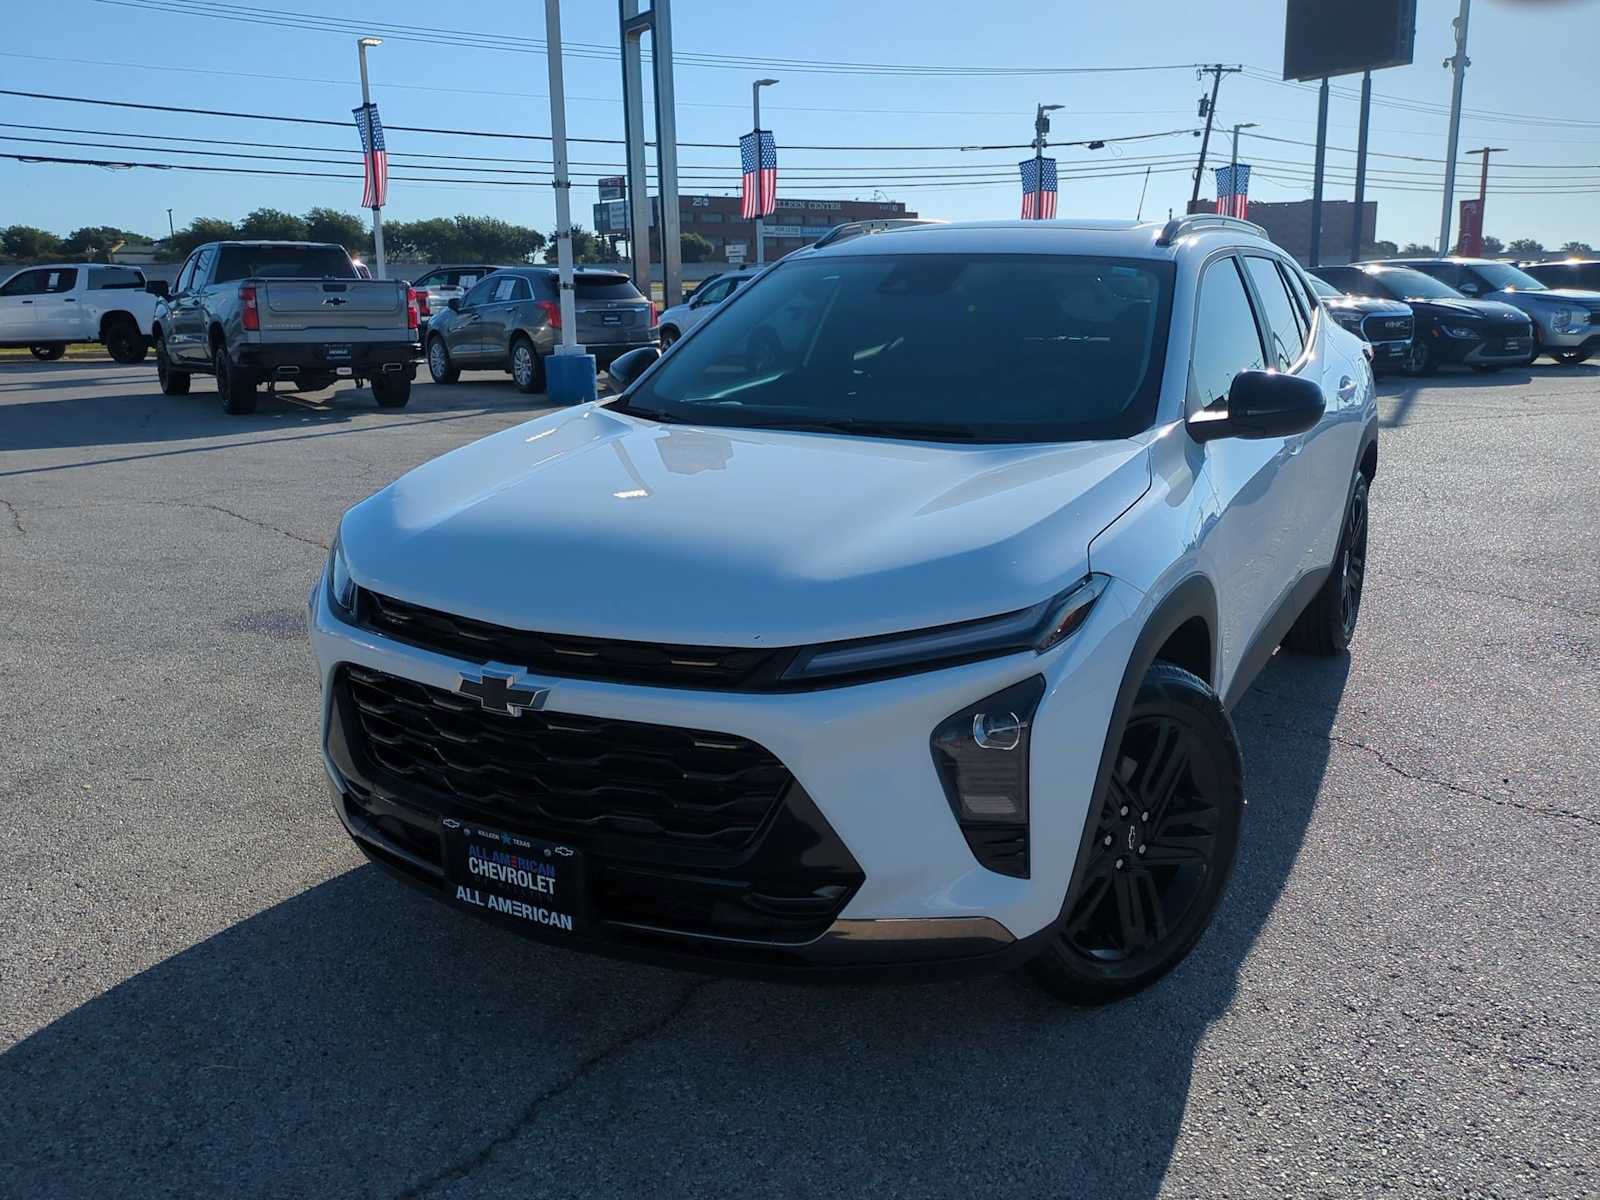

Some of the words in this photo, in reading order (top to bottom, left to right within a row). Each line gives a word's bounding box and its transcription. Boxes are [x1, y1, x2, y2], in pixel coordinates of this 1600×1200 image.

[808, 201, 841, 210] CENTER
[478, 830, 500, 840] KILLEEN
[513, 838, 530, 848] TEXAS
[469, 845, 489, 860] ALL
[492, 851, 555, 877] AMERICAN
[469, 857, 555, 895] CHEVROLET
[456, 886, 485, 906] ALL
[488, 895, 572, 930] AMERICAN
